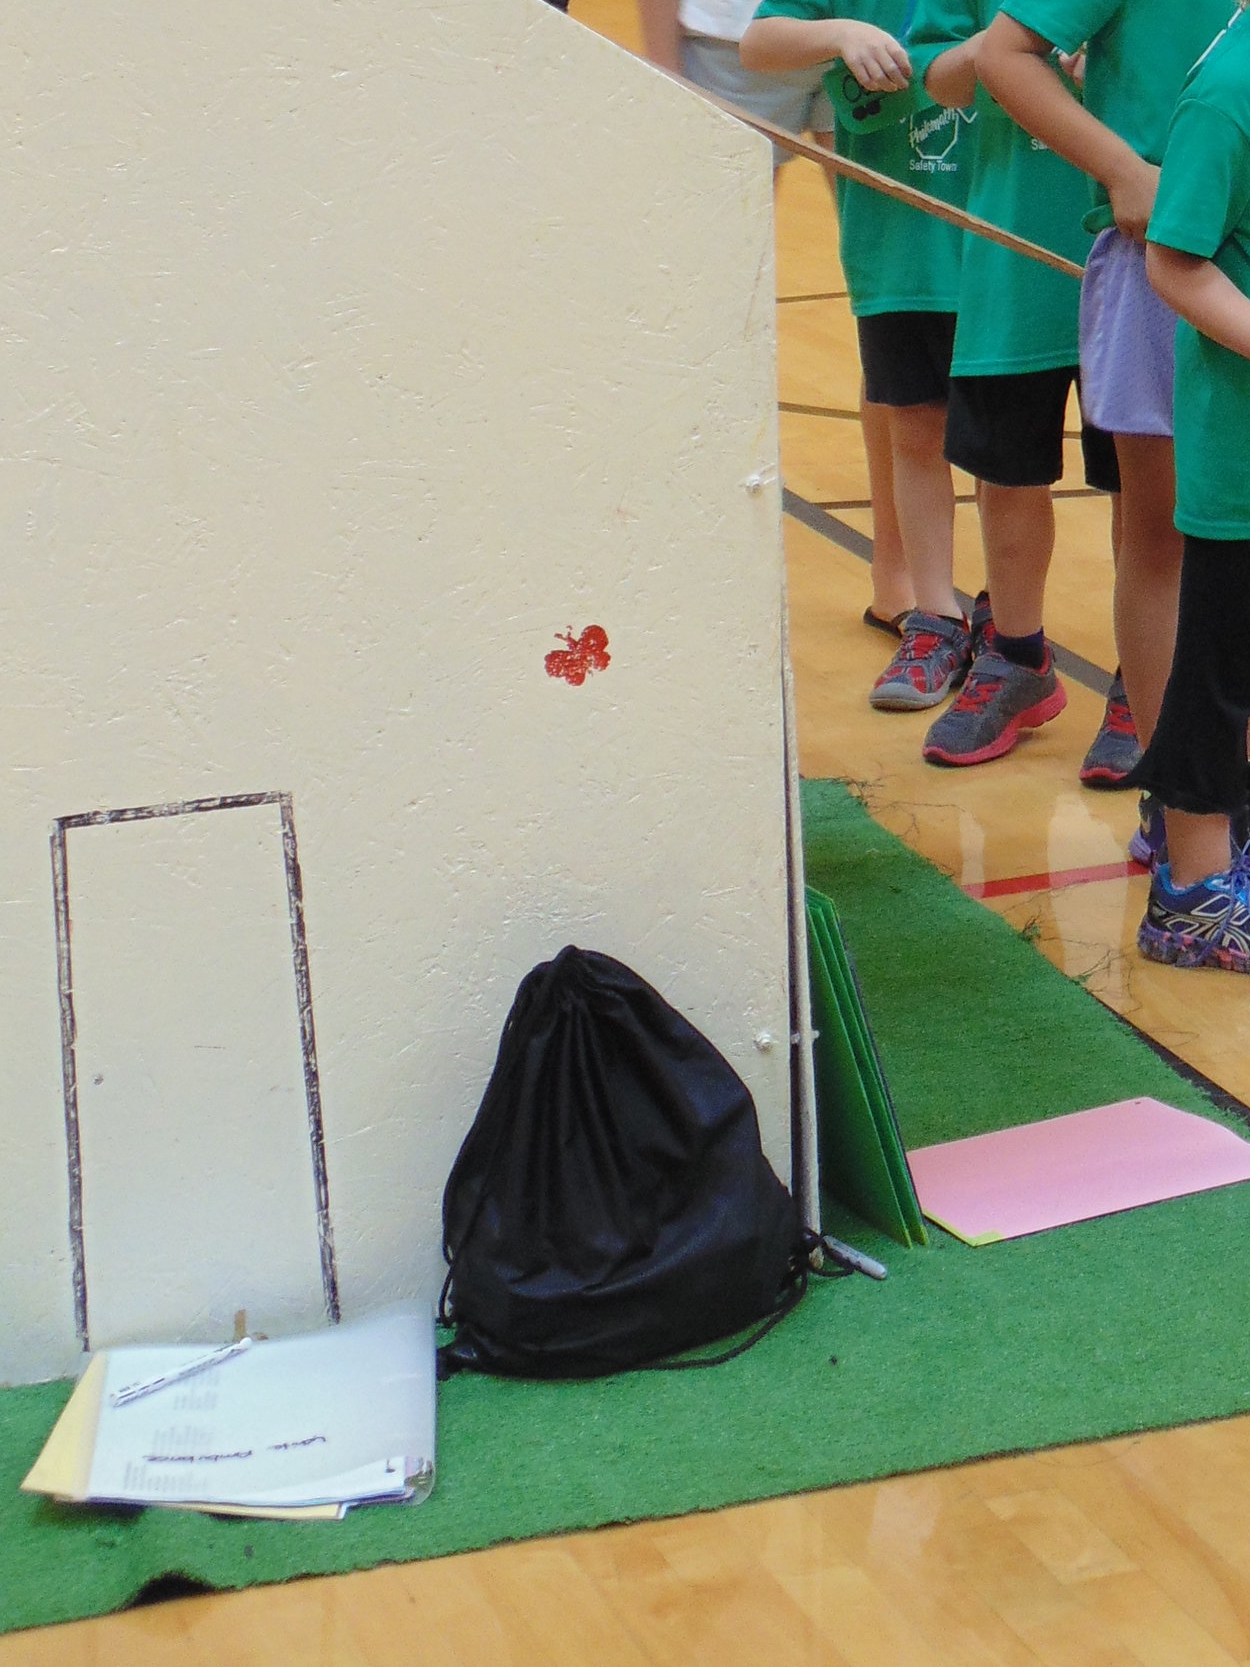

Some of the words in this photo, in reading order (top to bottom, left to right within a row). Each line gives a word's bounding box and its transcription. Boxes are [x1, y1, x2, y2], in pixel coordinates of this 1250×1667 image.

[910, 107, 957, 148] Philomath
[909, 159, 935, 174] Safety
[937, 160, 958, 172] Town
